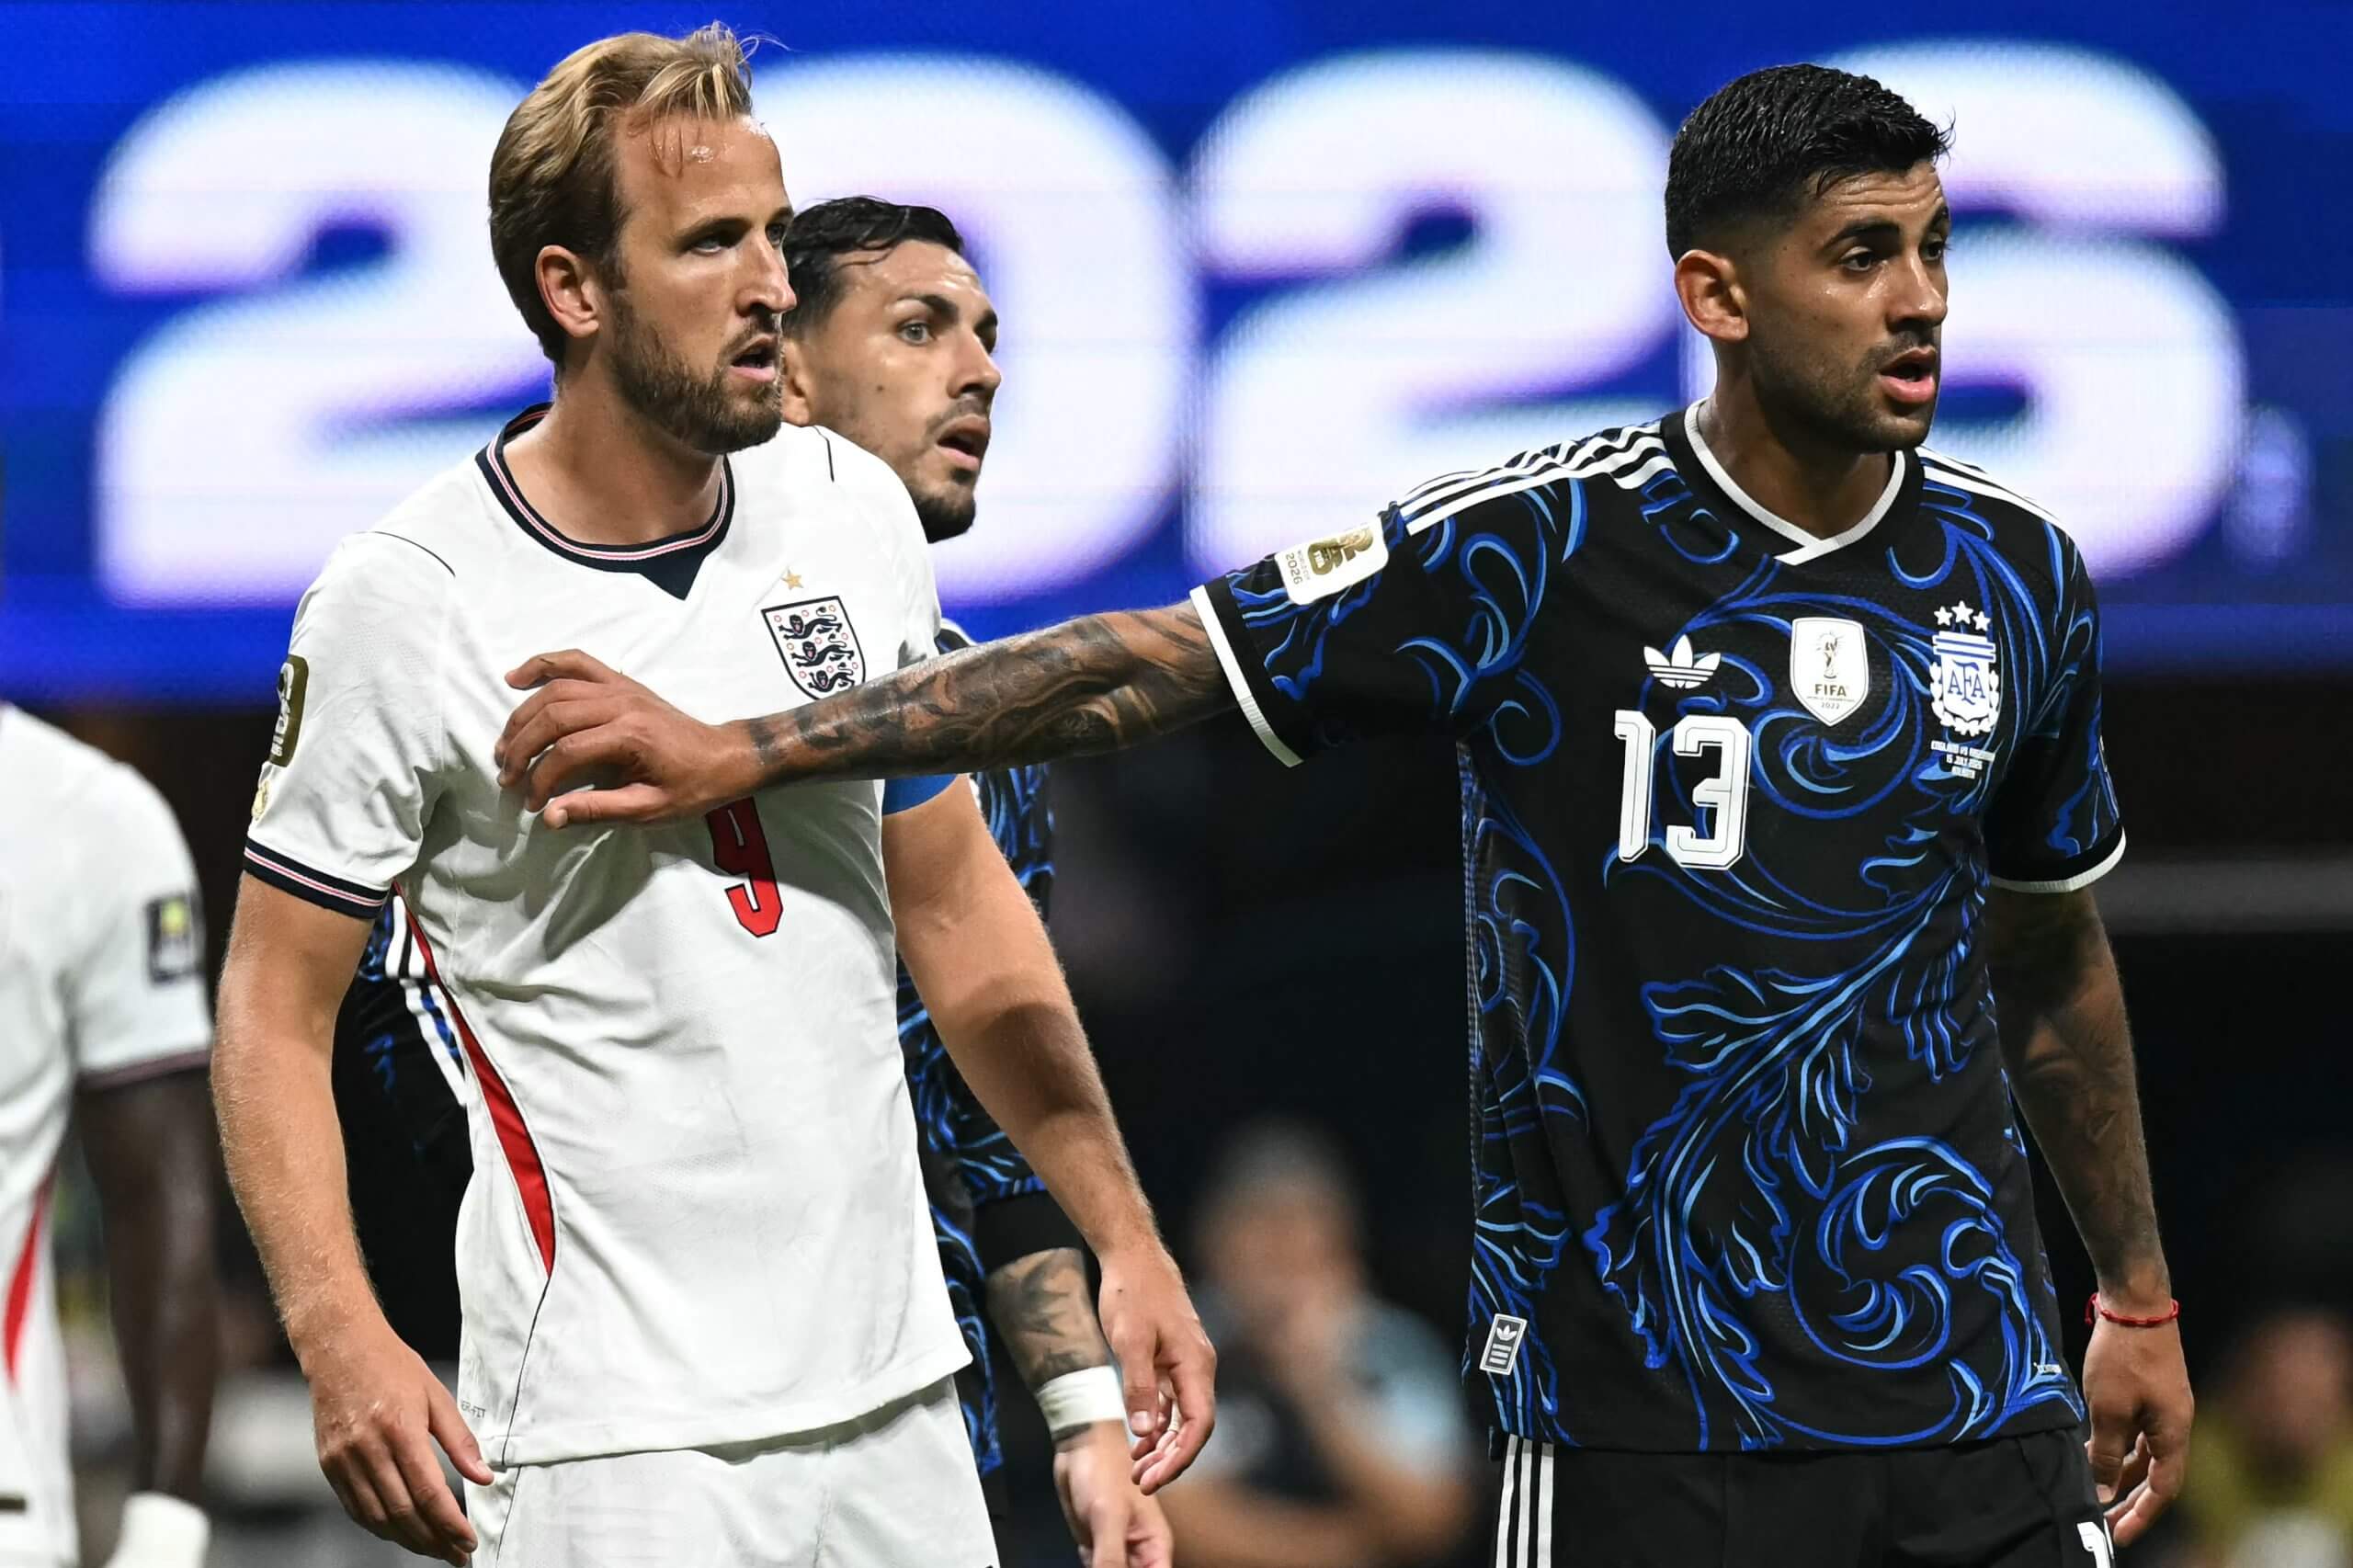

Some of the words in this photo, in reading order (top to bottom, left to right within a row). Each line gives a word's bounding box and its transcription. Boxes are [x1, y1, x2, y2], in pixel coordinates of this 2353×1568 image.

[1285, 552, 1303, 585] 2026
[1814, 683, 1847, 697] FIFA
[1947, 658, 1986, 706] AFA
[1614, 709, 1753, 871] 13
[704, 796, 784, 938] 9
